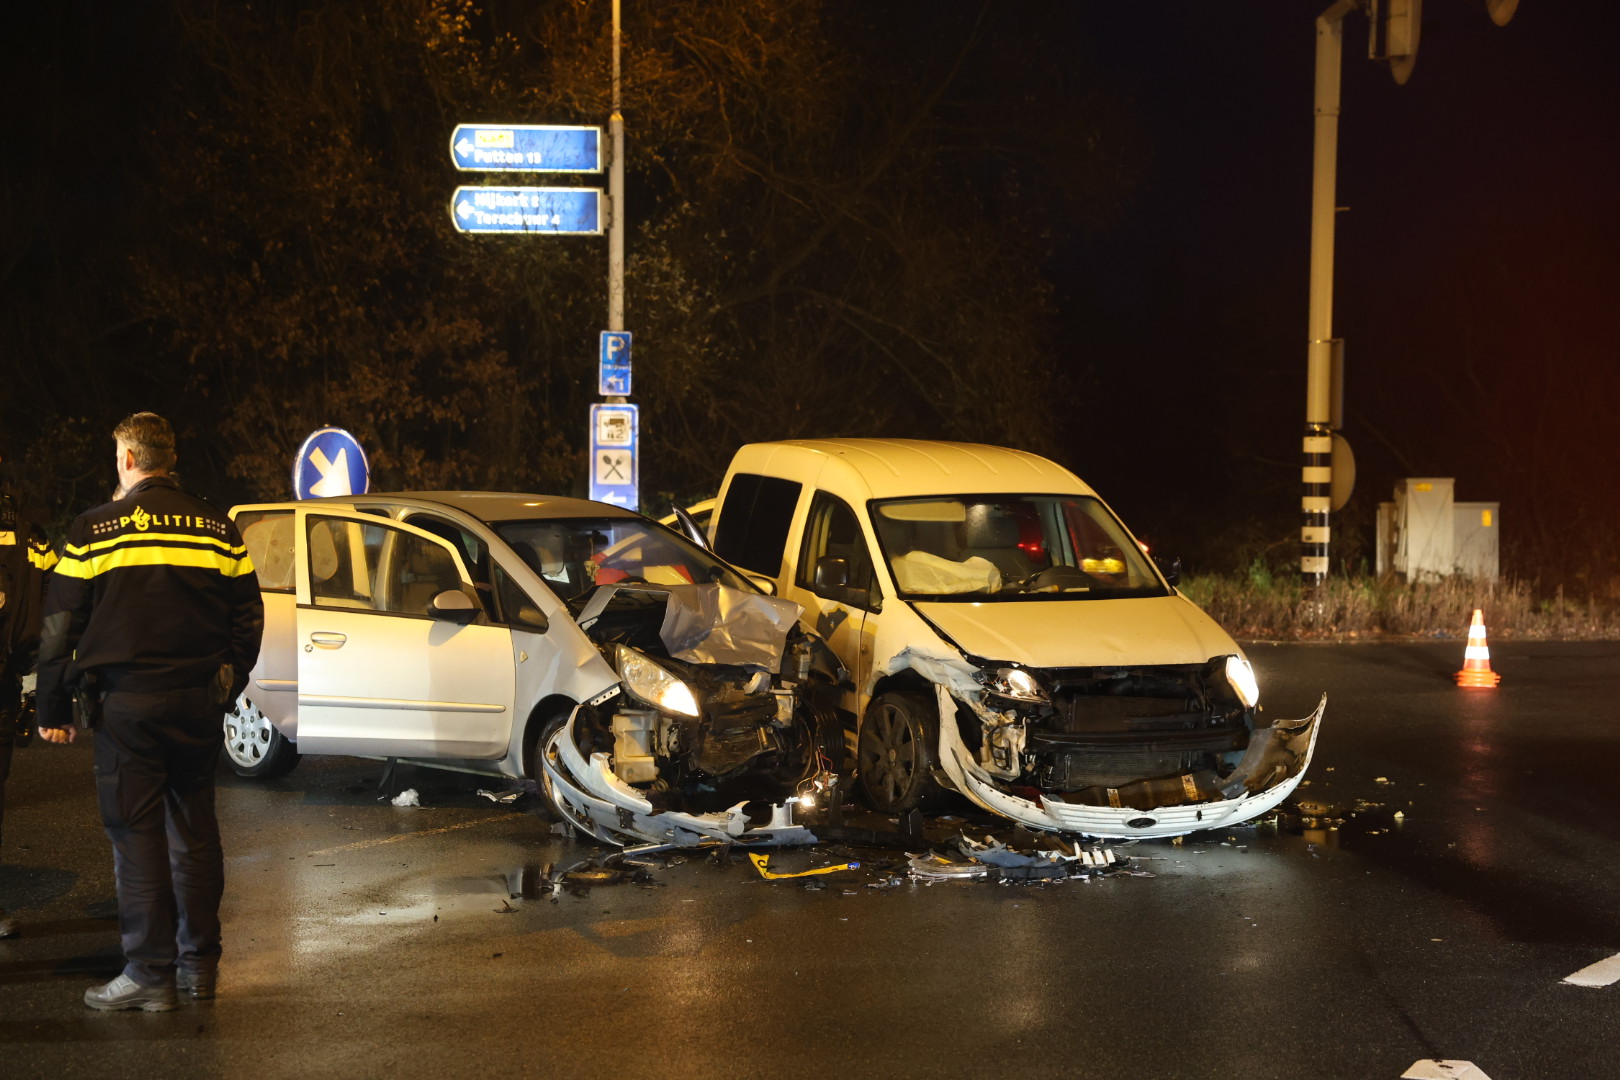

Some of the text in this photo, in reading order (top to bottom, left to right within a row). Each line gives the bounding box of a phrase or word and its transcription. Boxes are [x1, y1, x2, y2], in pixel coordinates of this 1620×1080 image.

[474, 149, 524, 164] Putten
[474, 192, 529, 209] Nijkerk
[474, 211, 561, 226] Terschuur 4
[607, 335, 625, 361] P
